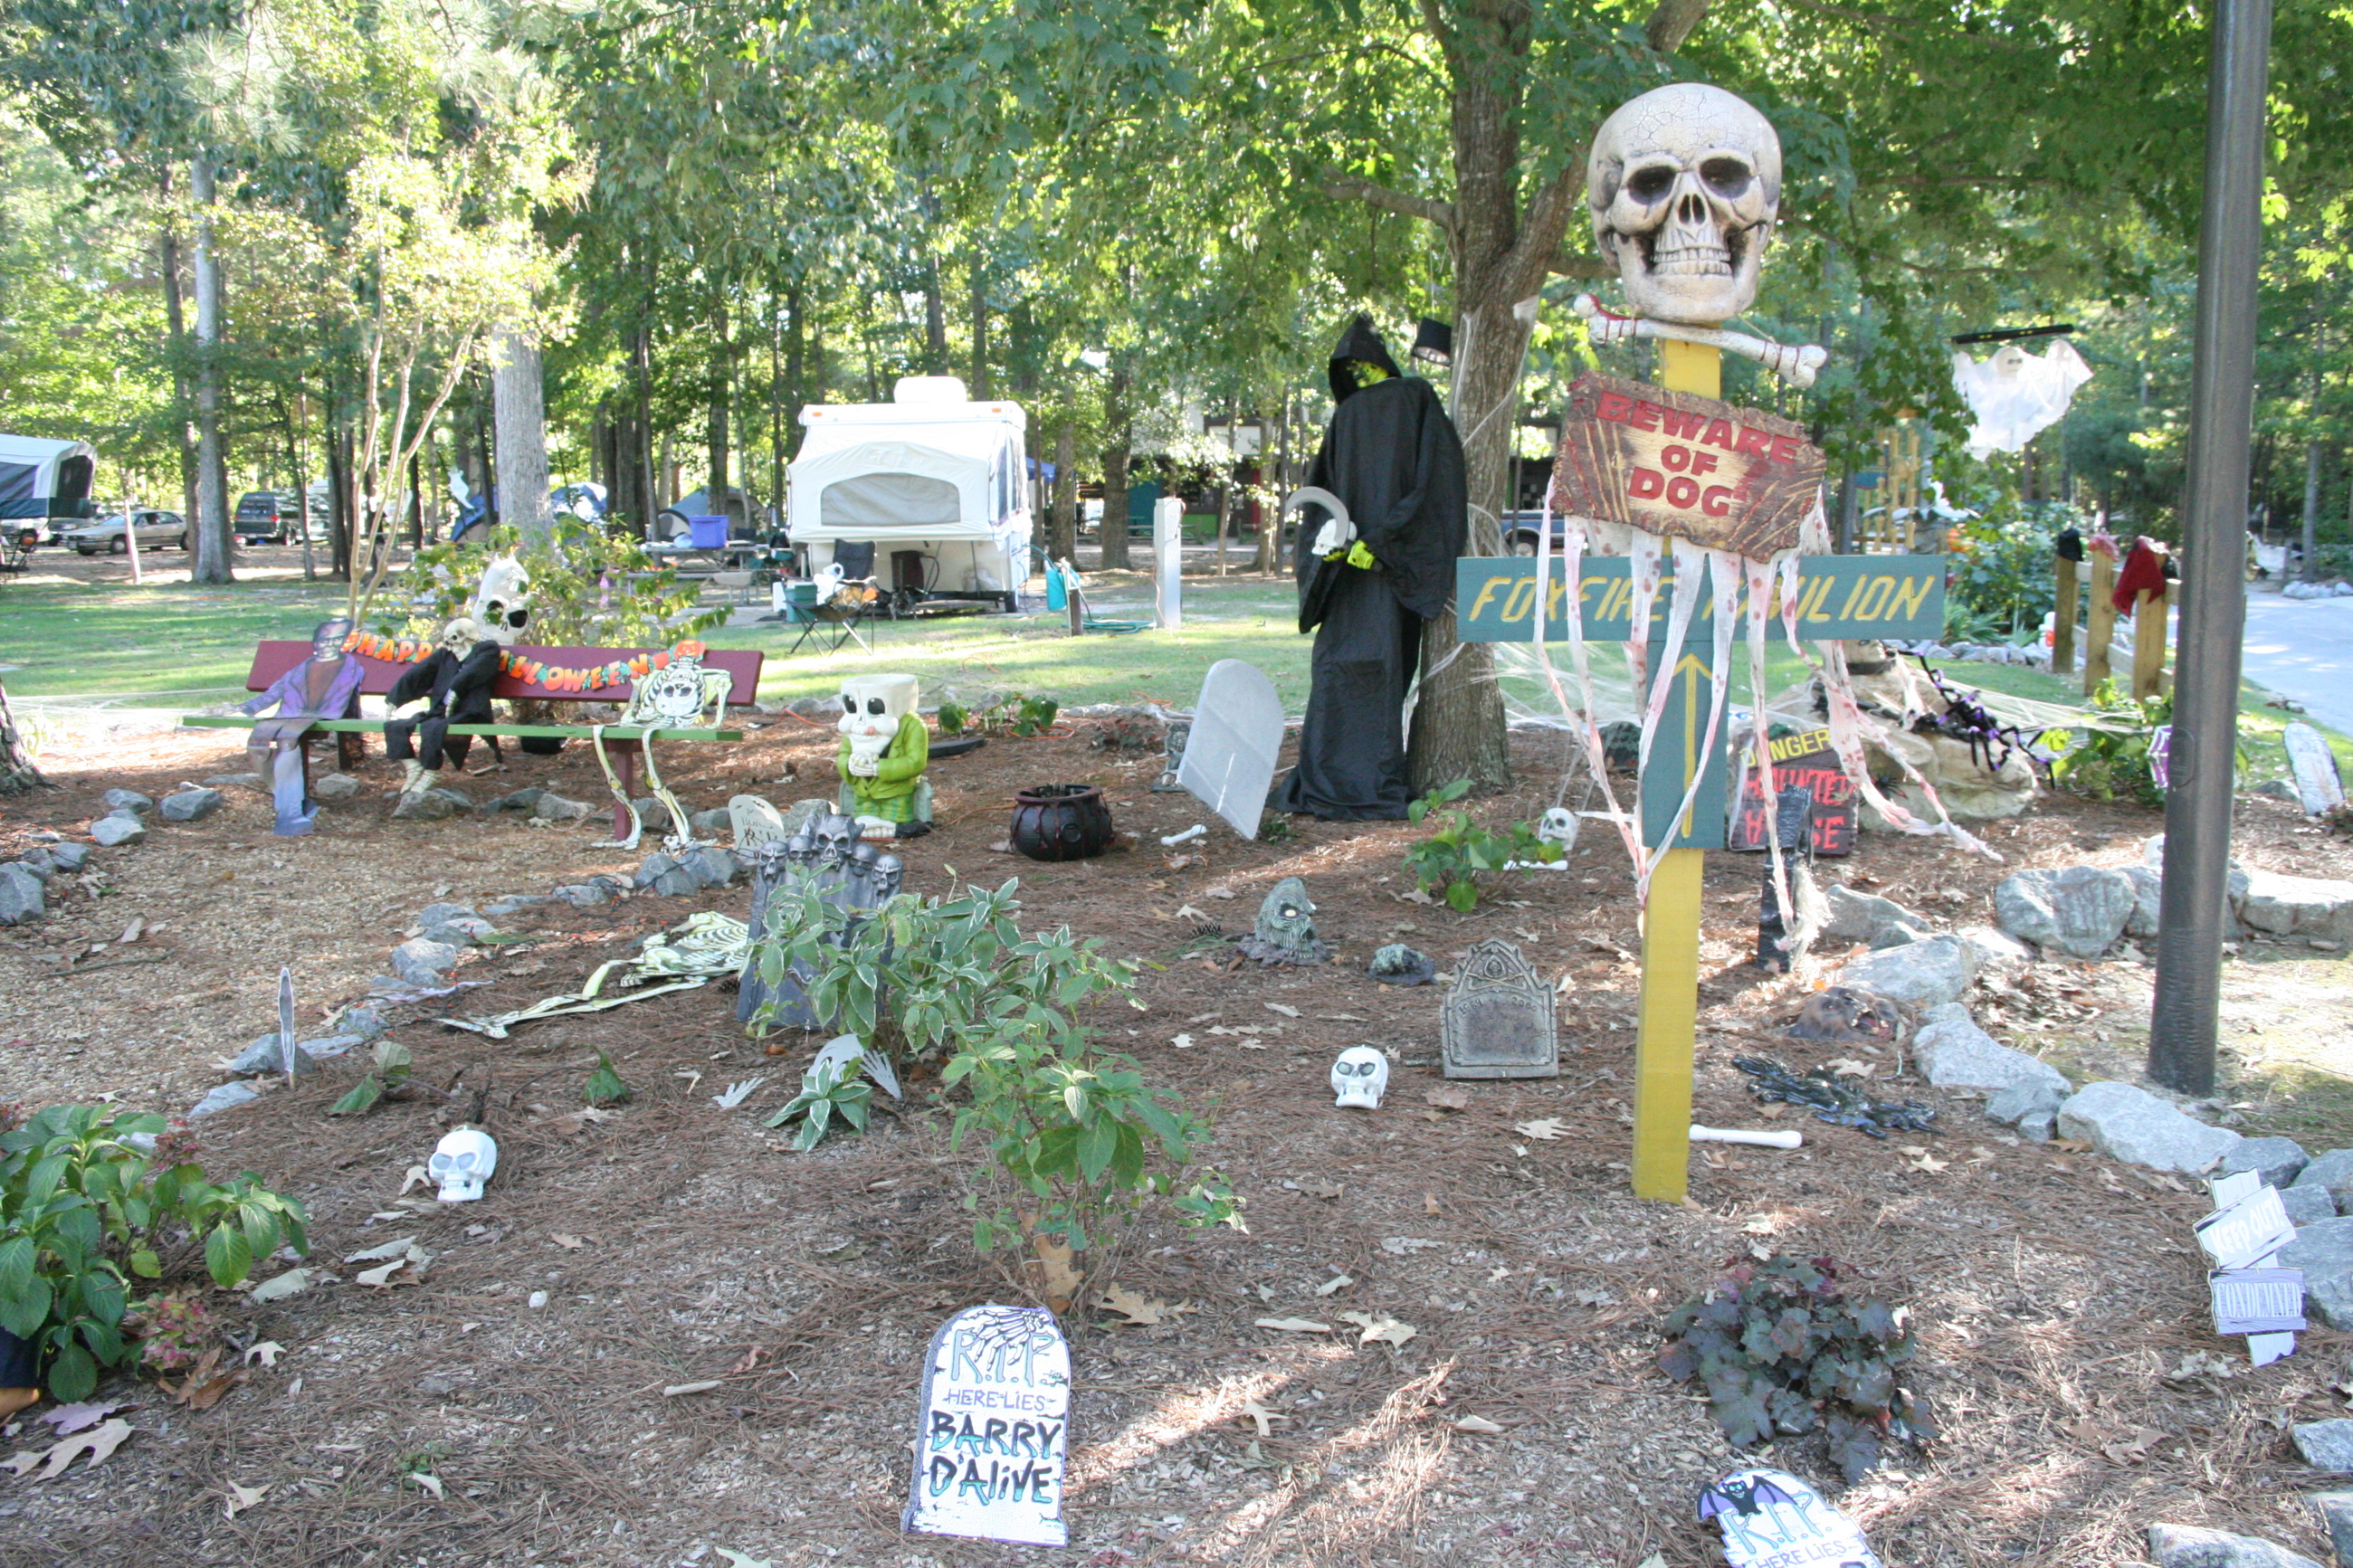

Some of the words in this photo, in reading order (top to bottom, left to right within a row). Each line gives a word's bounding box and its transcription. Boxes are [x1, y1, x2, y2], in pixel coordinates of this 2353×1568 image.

[1596, 390, 1802, 465] BEWARE
[1661, 444, 1719, 477] OF
[1628, 466, 1735, 518] DOG
[356, 633, 443, 663] HAPP
[500, 649, 648, 692] LLOWEEN
[1739, 728, 1833, 767] DNGER
[1511, 996, 1538, 1012] 2000
[2209, 1219, 2252, 1261] KEEP
[948, 1389, 998, 1409] HERE
[930, 1410, 1062, 1459] BARRY
